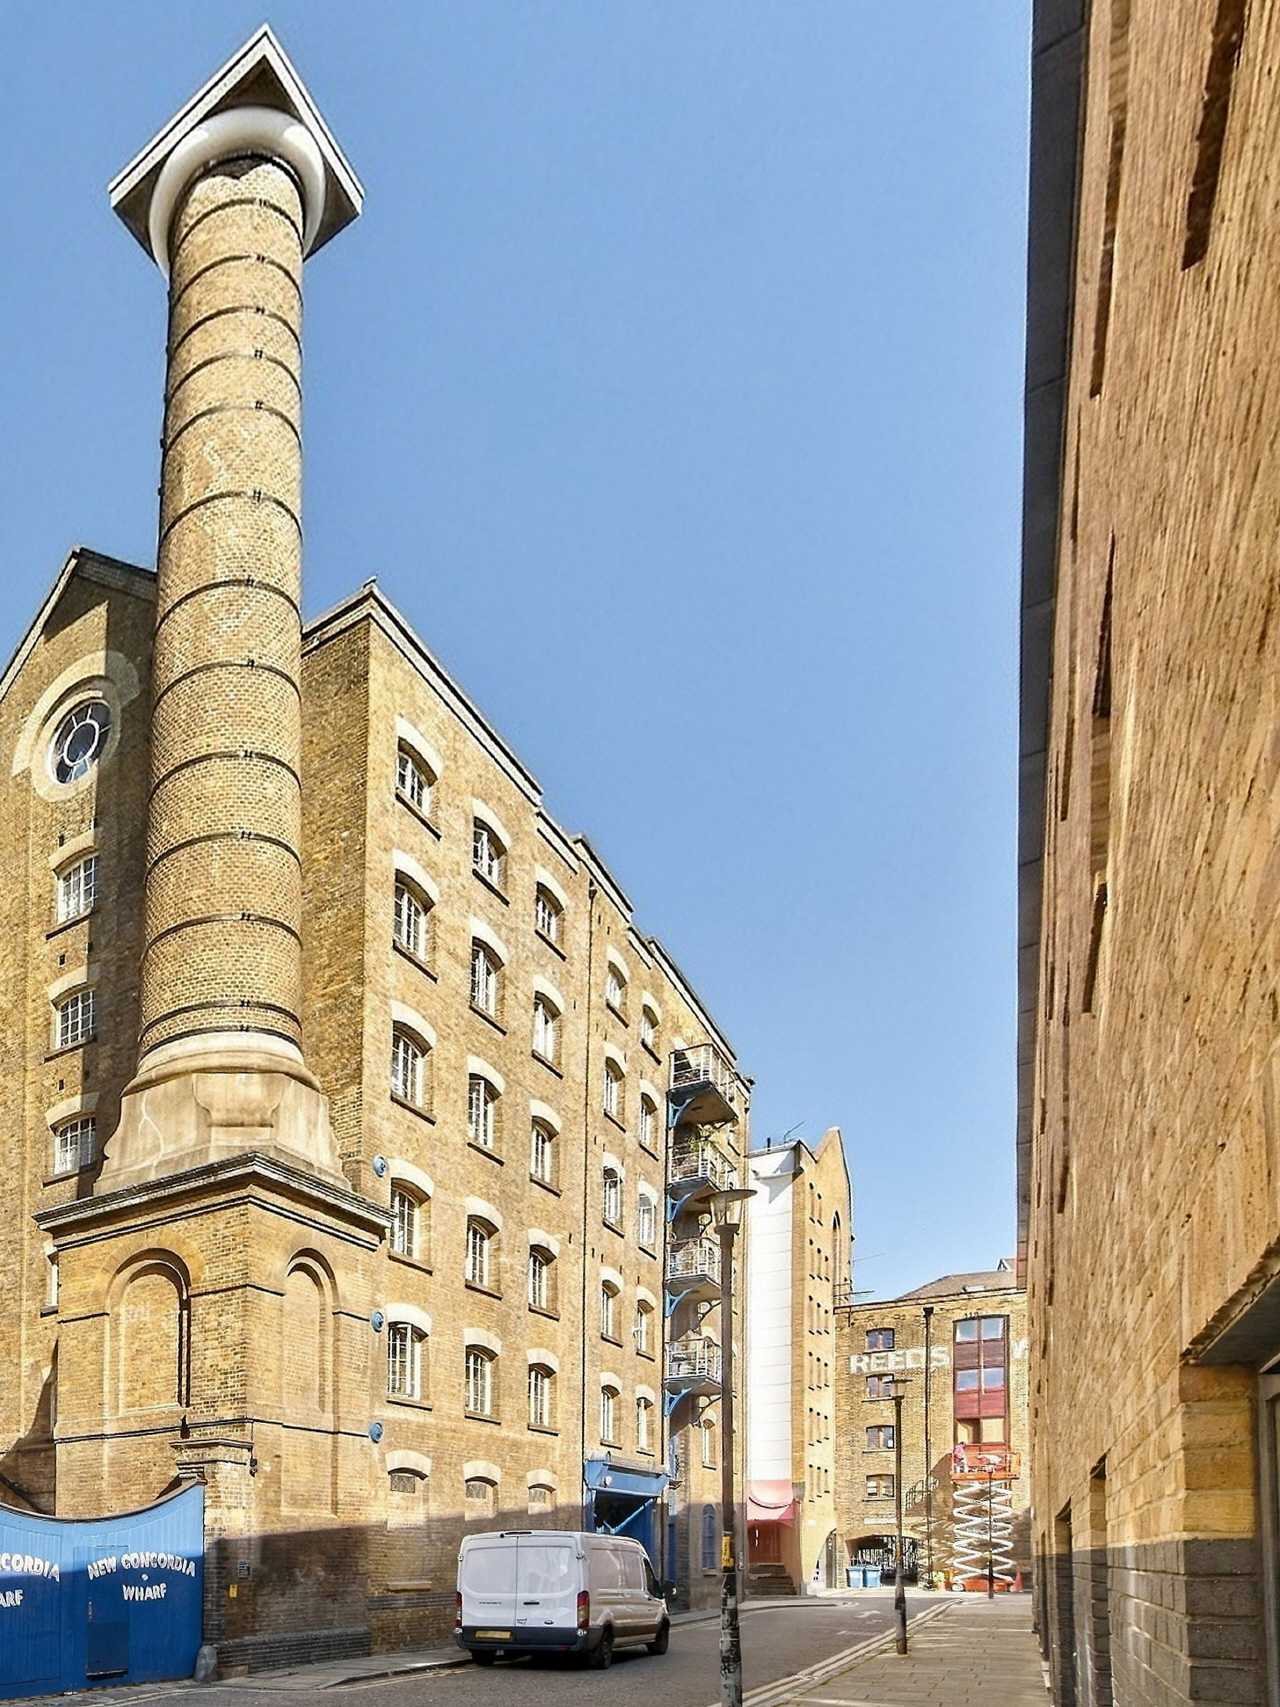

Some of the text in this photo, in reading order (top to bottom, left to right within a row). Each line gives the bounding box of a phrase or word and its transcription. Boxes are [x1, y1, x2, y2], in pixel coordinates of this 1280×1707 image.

[87, 1552, 196, 1580] NEW CONCORDIA
[122, 1583, 167, 1600] WHARF
